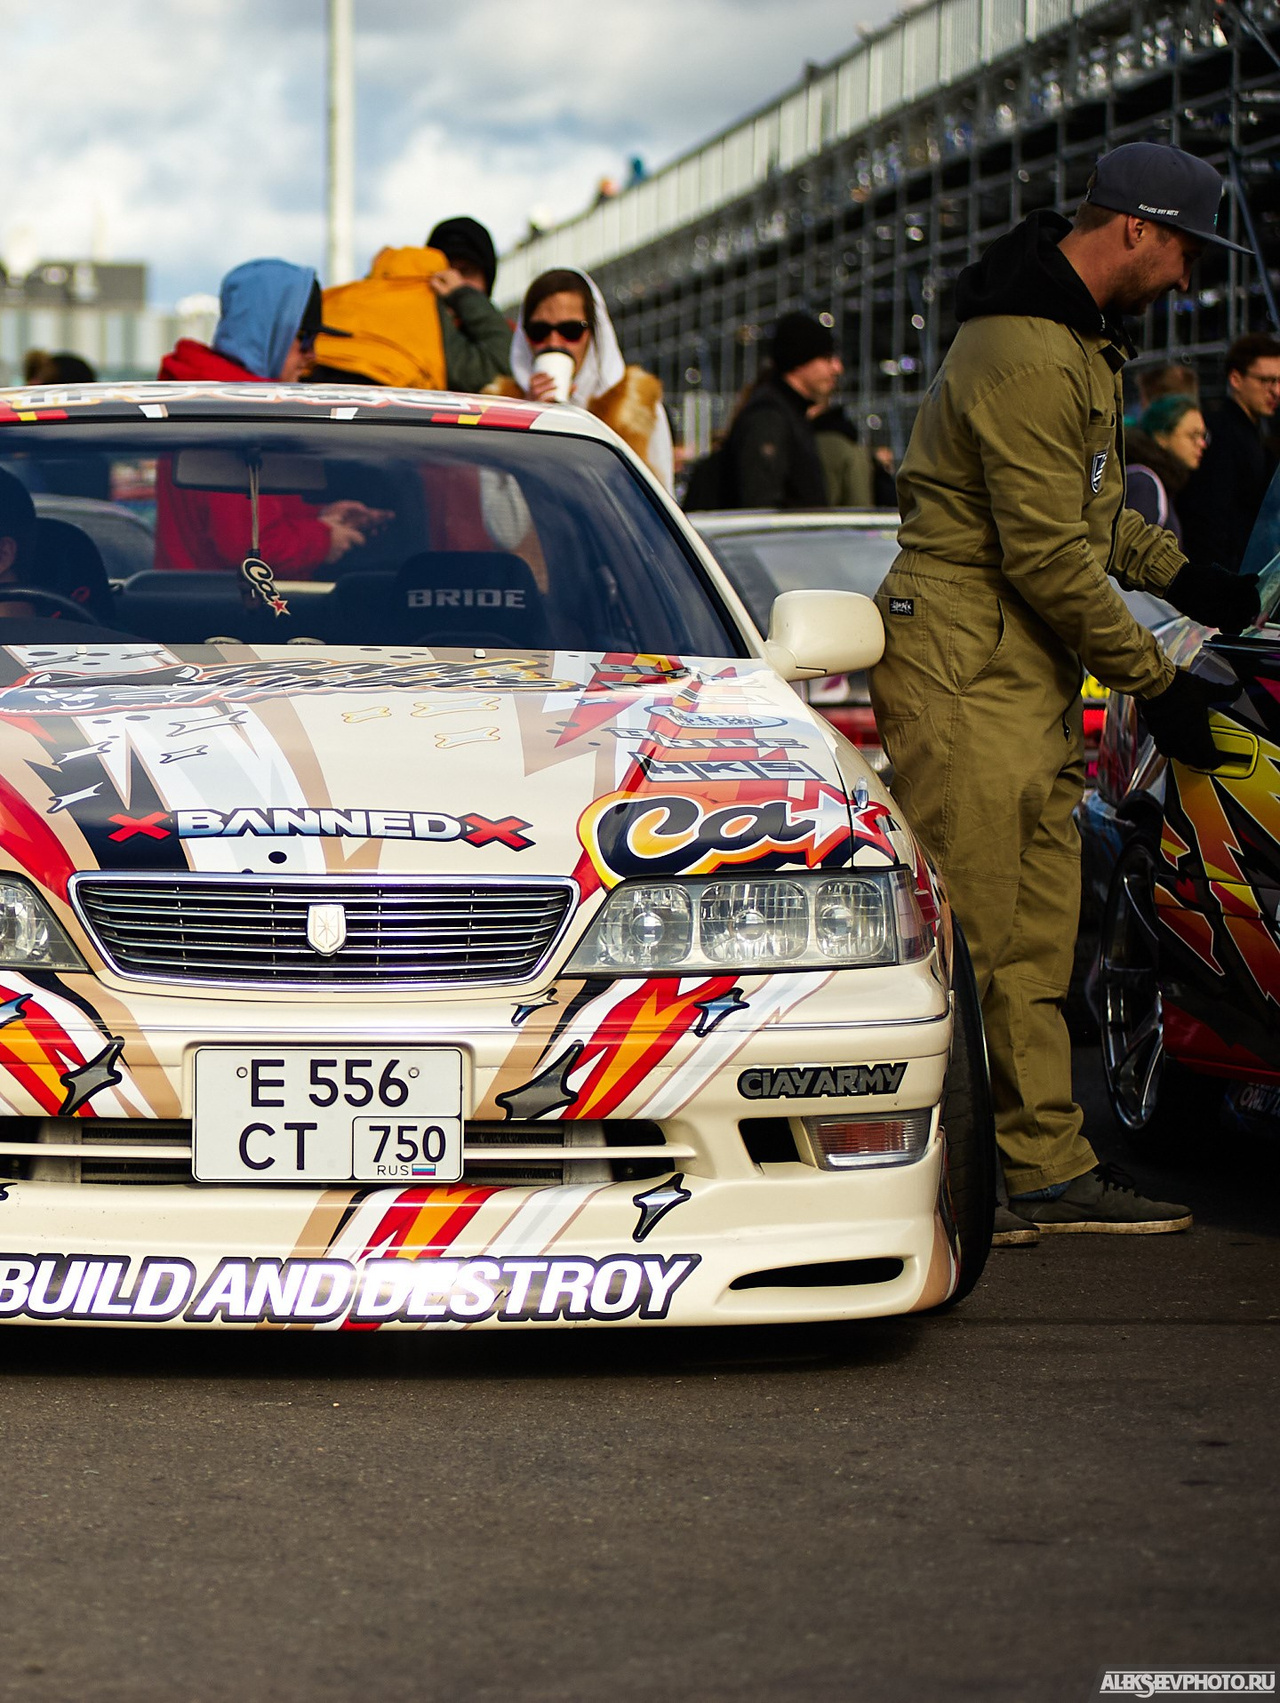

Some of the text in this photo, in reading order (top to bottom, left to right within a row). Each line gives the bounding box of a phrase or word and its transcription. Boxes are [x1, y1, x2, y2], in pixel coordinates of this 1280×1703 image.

[407, 588, 527, 608] BRIDE
[603, 728, 808, 749] BRIDE
[634, 756, 820, 781] HKS
[308, 1058, 409, 1108] 556
[238, 1122, 318, 1171] CT
[368, 1125, 447, 1163] 750
[376, 1164, 409, 1176] RUS
[194, 1259, 354, 1318] AND
[352, 1257, 695, 1318] DESTROY
